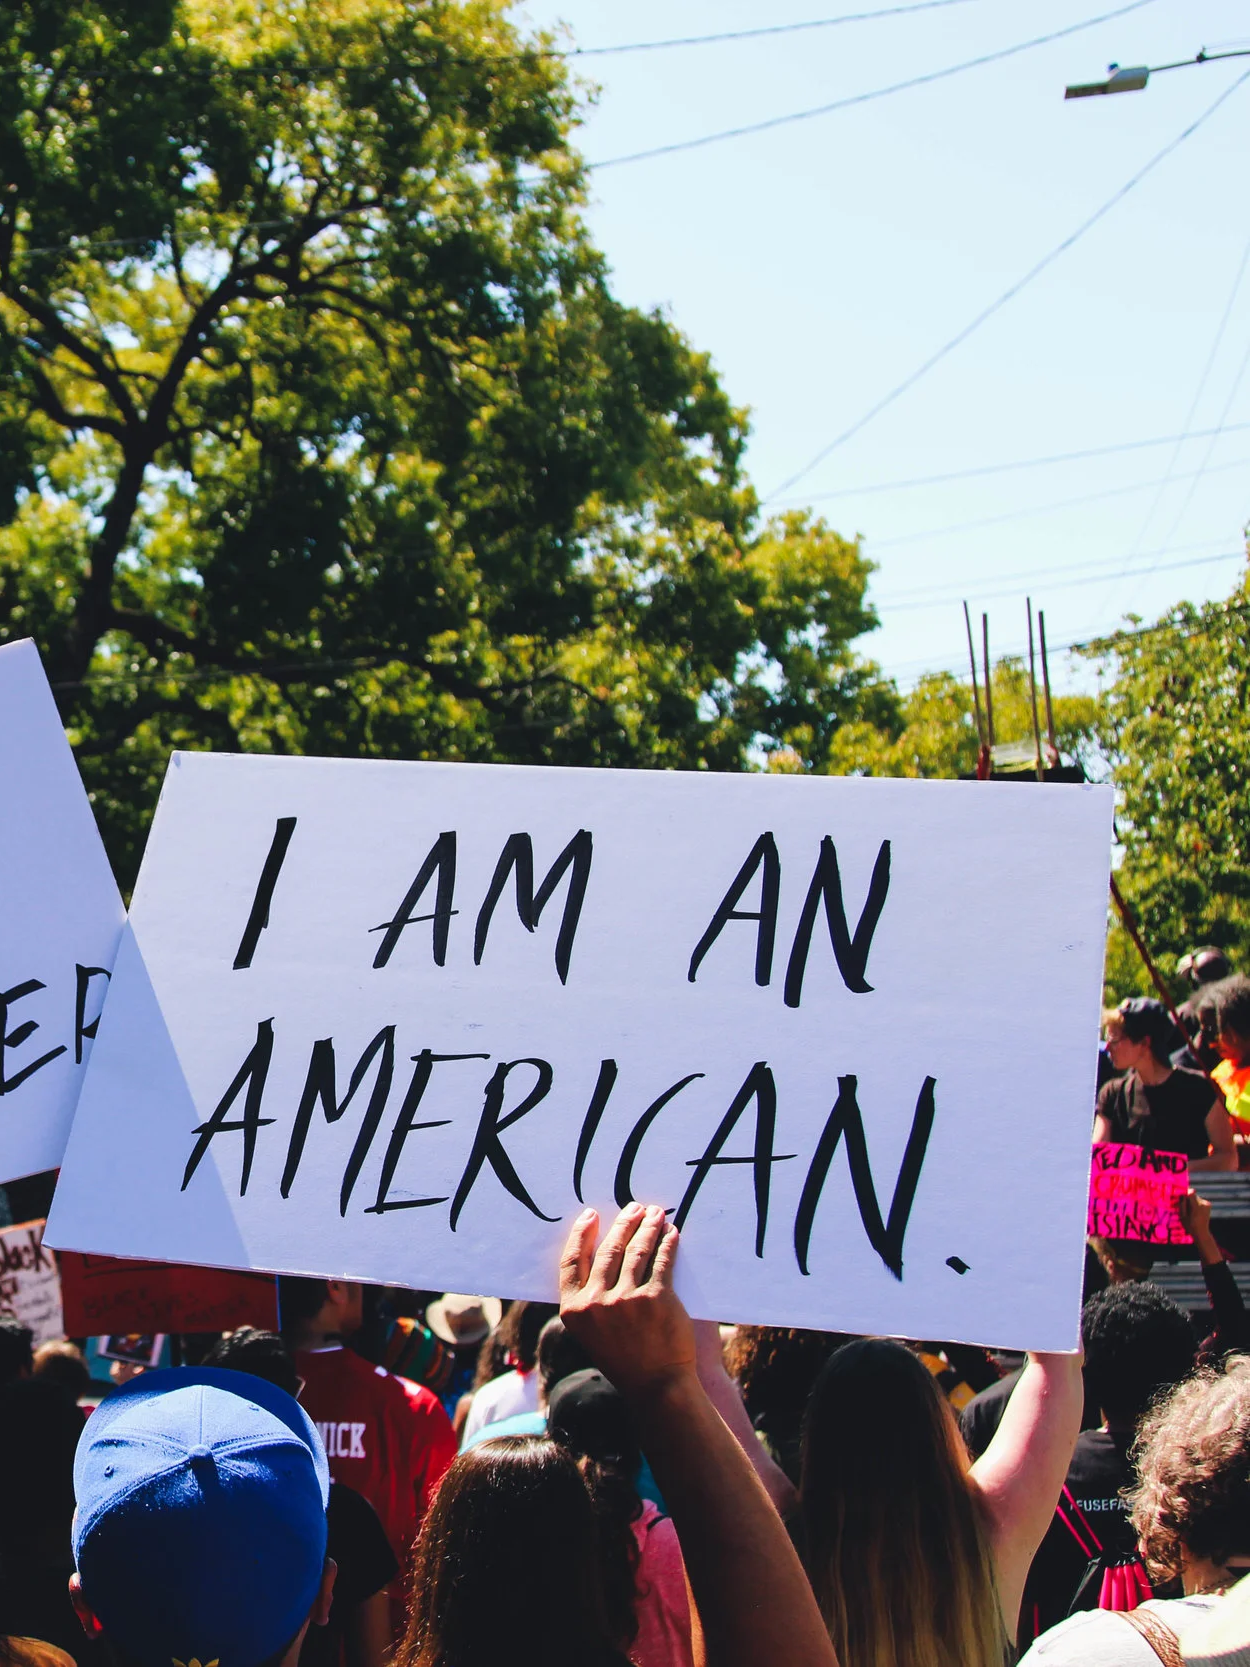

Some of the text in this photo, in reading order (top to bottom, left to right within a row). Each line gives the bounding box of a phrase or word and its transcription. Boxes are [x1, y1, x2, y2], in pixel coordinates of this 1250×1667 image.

[232, 816, 890, 1008] I AM AN
[180, 1016, 971, 1281] AMERICAN.
